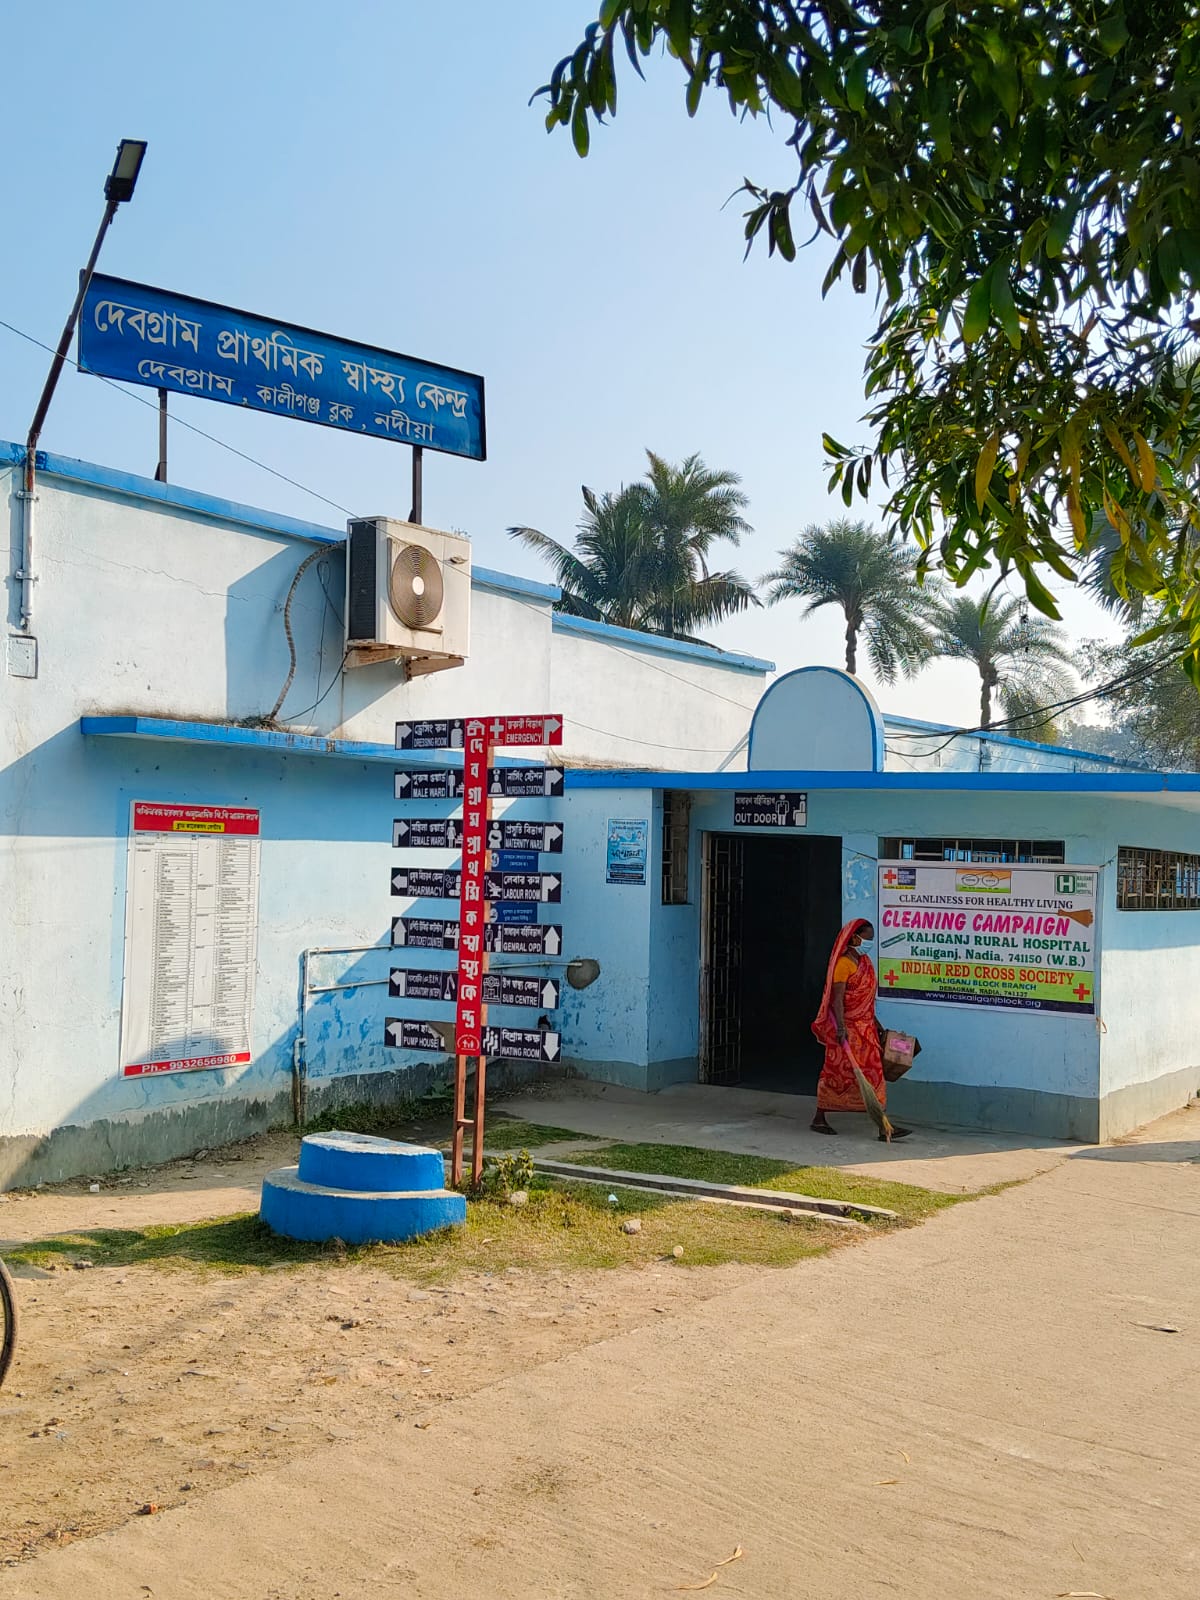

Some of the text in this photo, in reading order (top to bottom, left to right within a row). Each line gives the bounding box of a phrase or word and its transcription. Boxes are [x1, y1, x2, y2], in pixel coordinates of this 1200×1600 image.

[94, 300, 470, 419] দেবগ্রাম প্রাথমিক স্বাস্থ্য কেন্দ্র
[256, 382, 320, 418] কালীগঞ্জ
[375, 411, 435, 442] নদীয়া
[414, 737, 447, 747] DRESSING ROOM
[506, 732, 542, 744] EMERGENCY
[413, 787, 445, 798] MALE WARD
[507, 786, 544, 795] NURSING STATION
[735, 813, 778, 824] OUT DOOR
[411, 836, 445, 846] FEMALE WARD
[505, 839, 543, 850] MATERNITY WARD
[504, 875, 540, 886] লেবার রুম
[408, 885, 443, 897] PHARMACY
[503, 888, 541, 900] LABOUR ROOM
[899, 894, 1073, 910] CLEANLINESS FOR HEALTHY LIVING
[882, 910, 1070, 936] CLEANING CAMPAIGN
[528, 942, 541, 953] OPD
[907, 932, 1090, 953] KALIGANJ RURAL HOSPITAL
[1008, 953, 1042, 964] 741150
[1046, 953, 1086, 968] (W.B.)
[901, 961, 1075, 985] INDIAN RED CROSS SOCIETY
[931, 977, 1037, 991] KALIGANJ BLOCK BRANCH
[502, 994, 538, 1006] SUB CENTRE
[502, 1029, 523, 1043] বিশ্রাম
[404, 1037, 438, 1048] PUMP HOUSE
[523, 1048, 540, 1058] ROOM
[169, 1055, 237, 1070] 9932656980
